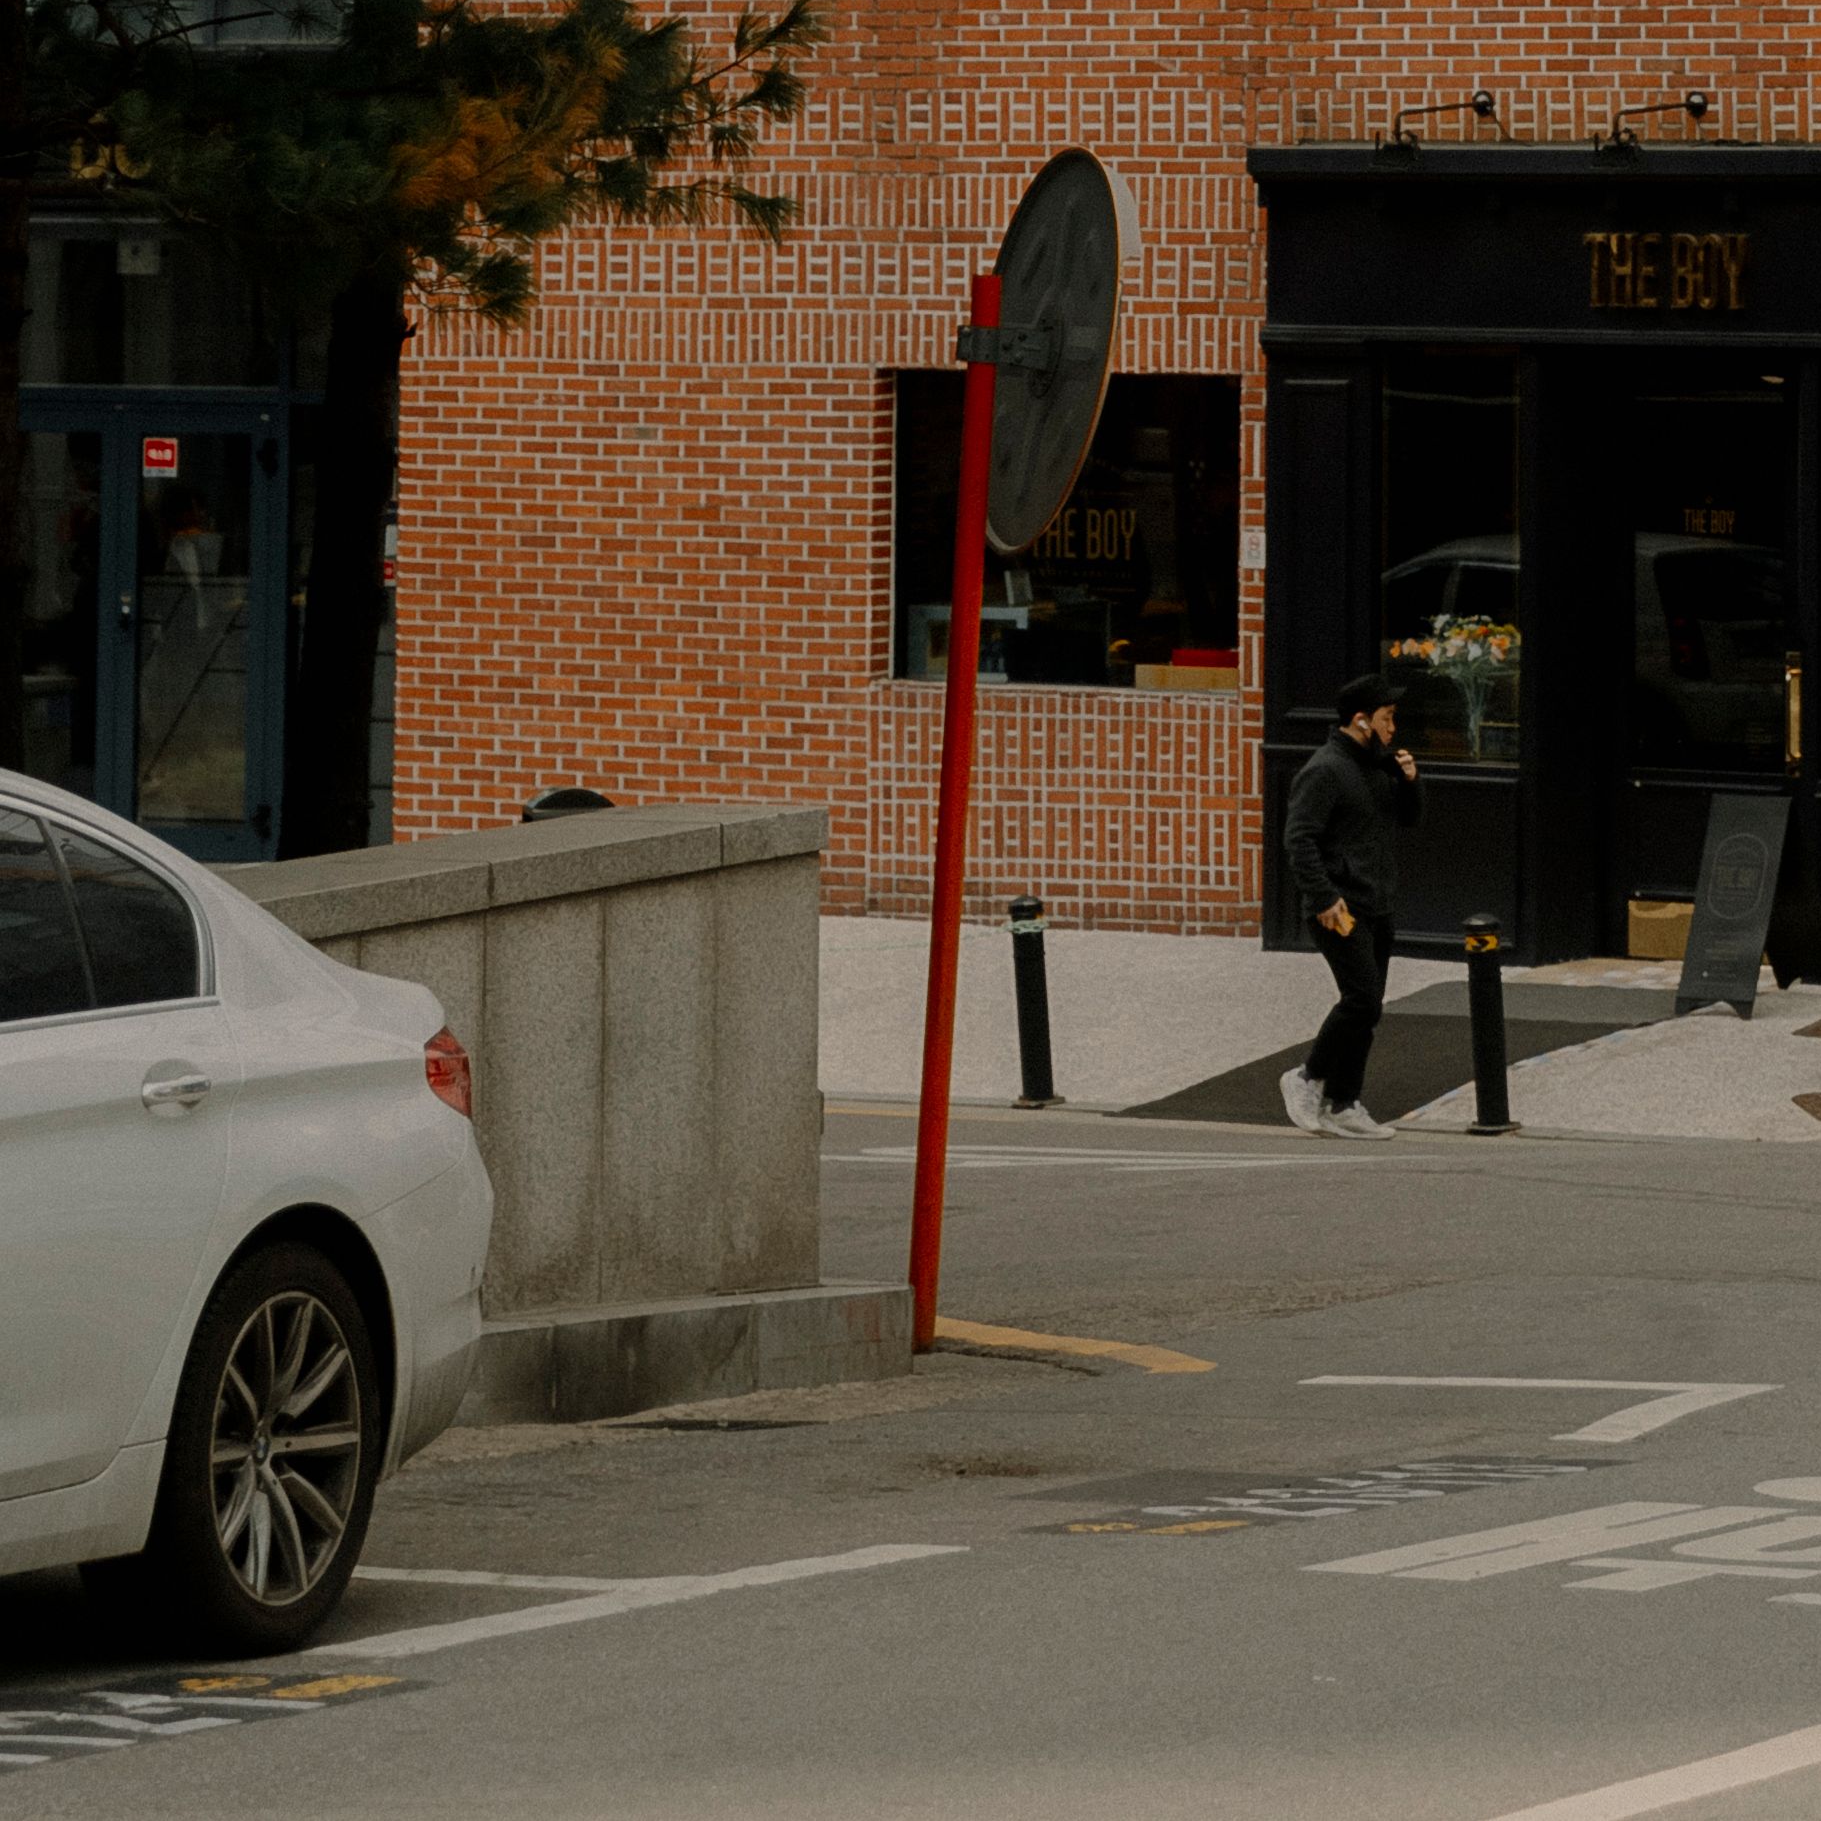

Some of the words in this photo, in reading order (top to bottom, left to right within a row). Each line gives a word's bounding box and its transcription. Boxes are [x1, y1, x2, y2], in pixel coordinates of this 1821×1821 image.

[1583, 231, 1664, 310] THE
[1669, 231, 1752, 311] BOY
[1085, 507, 1137, 561] BOY
[1682, 508, 1707, 534] THE
[1710, 509, 1737, 535] BOY
